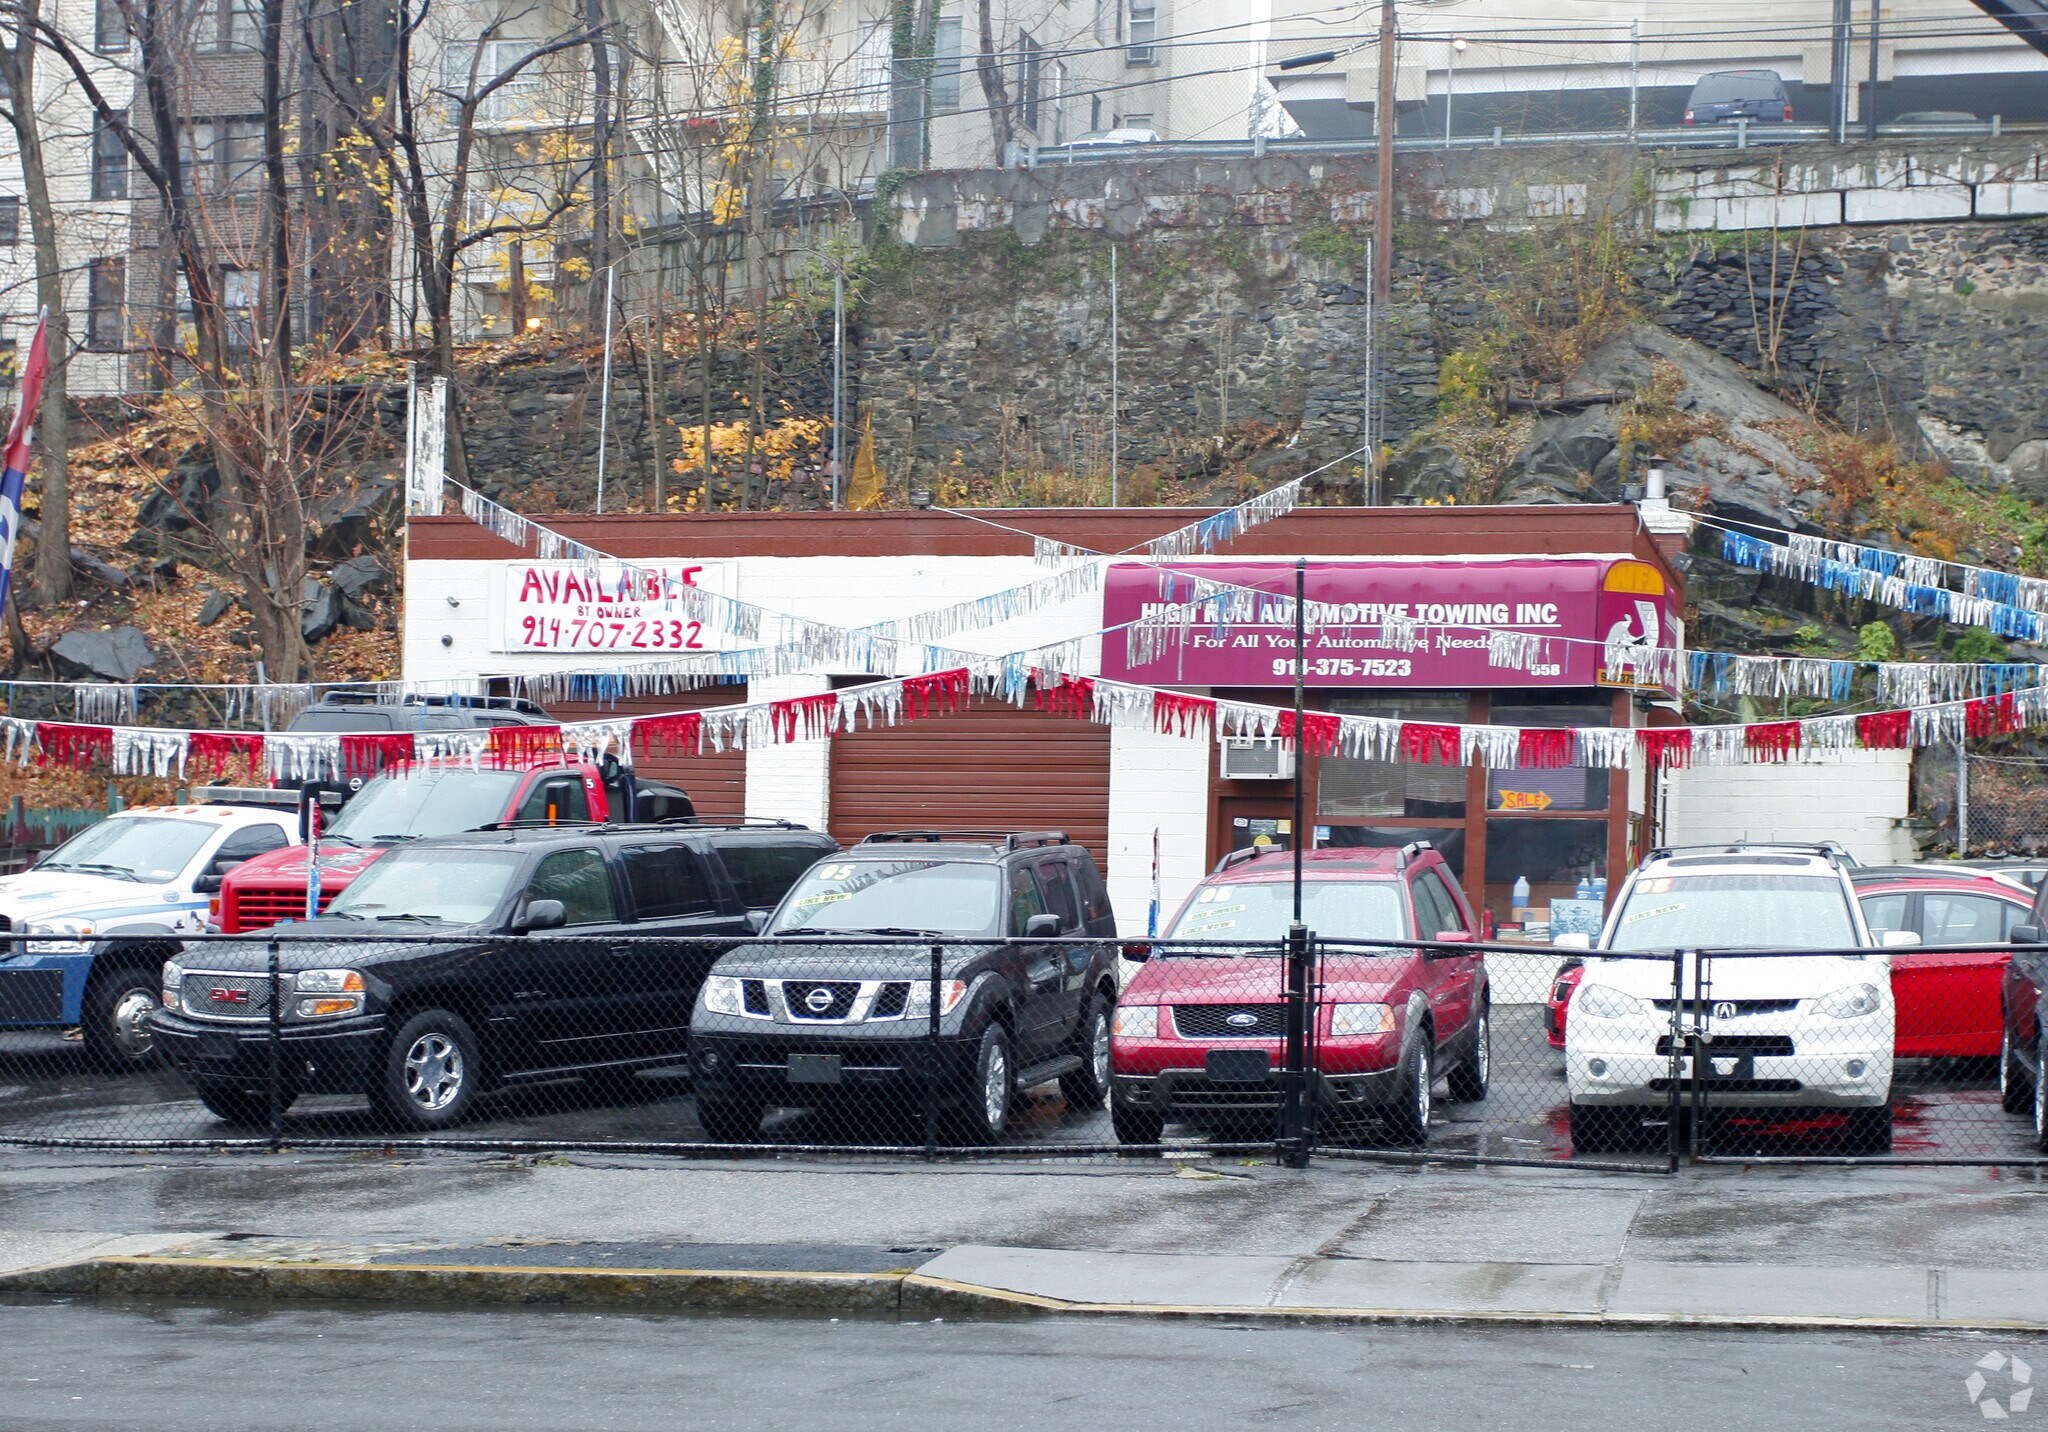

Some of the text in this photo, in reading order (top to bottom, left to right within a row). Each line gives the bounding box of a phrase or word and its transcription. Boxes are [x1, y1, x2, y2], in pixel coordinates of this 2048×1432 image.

[519, 566, 703, 604] AVAILABLE
[577, 606, 641, 619] BY OWNER
[1415, 603, 1509, 623] TOWING
[1516, 603, 1558, 624] INC
[1193, 635, 1227, 648] For
[1232, 634, 1259, 648] All
[1316, 635, 1429, 649] Automtve
[1531, 664, 1561, 676] 558
[585, 778, 595, 789] 5
[1506, 792, 1541, 808] SALE
[819, 864, 856, 880] 05
[823, 894, 847, 902] NEW
[209, 988, 248, 1002] GMC
